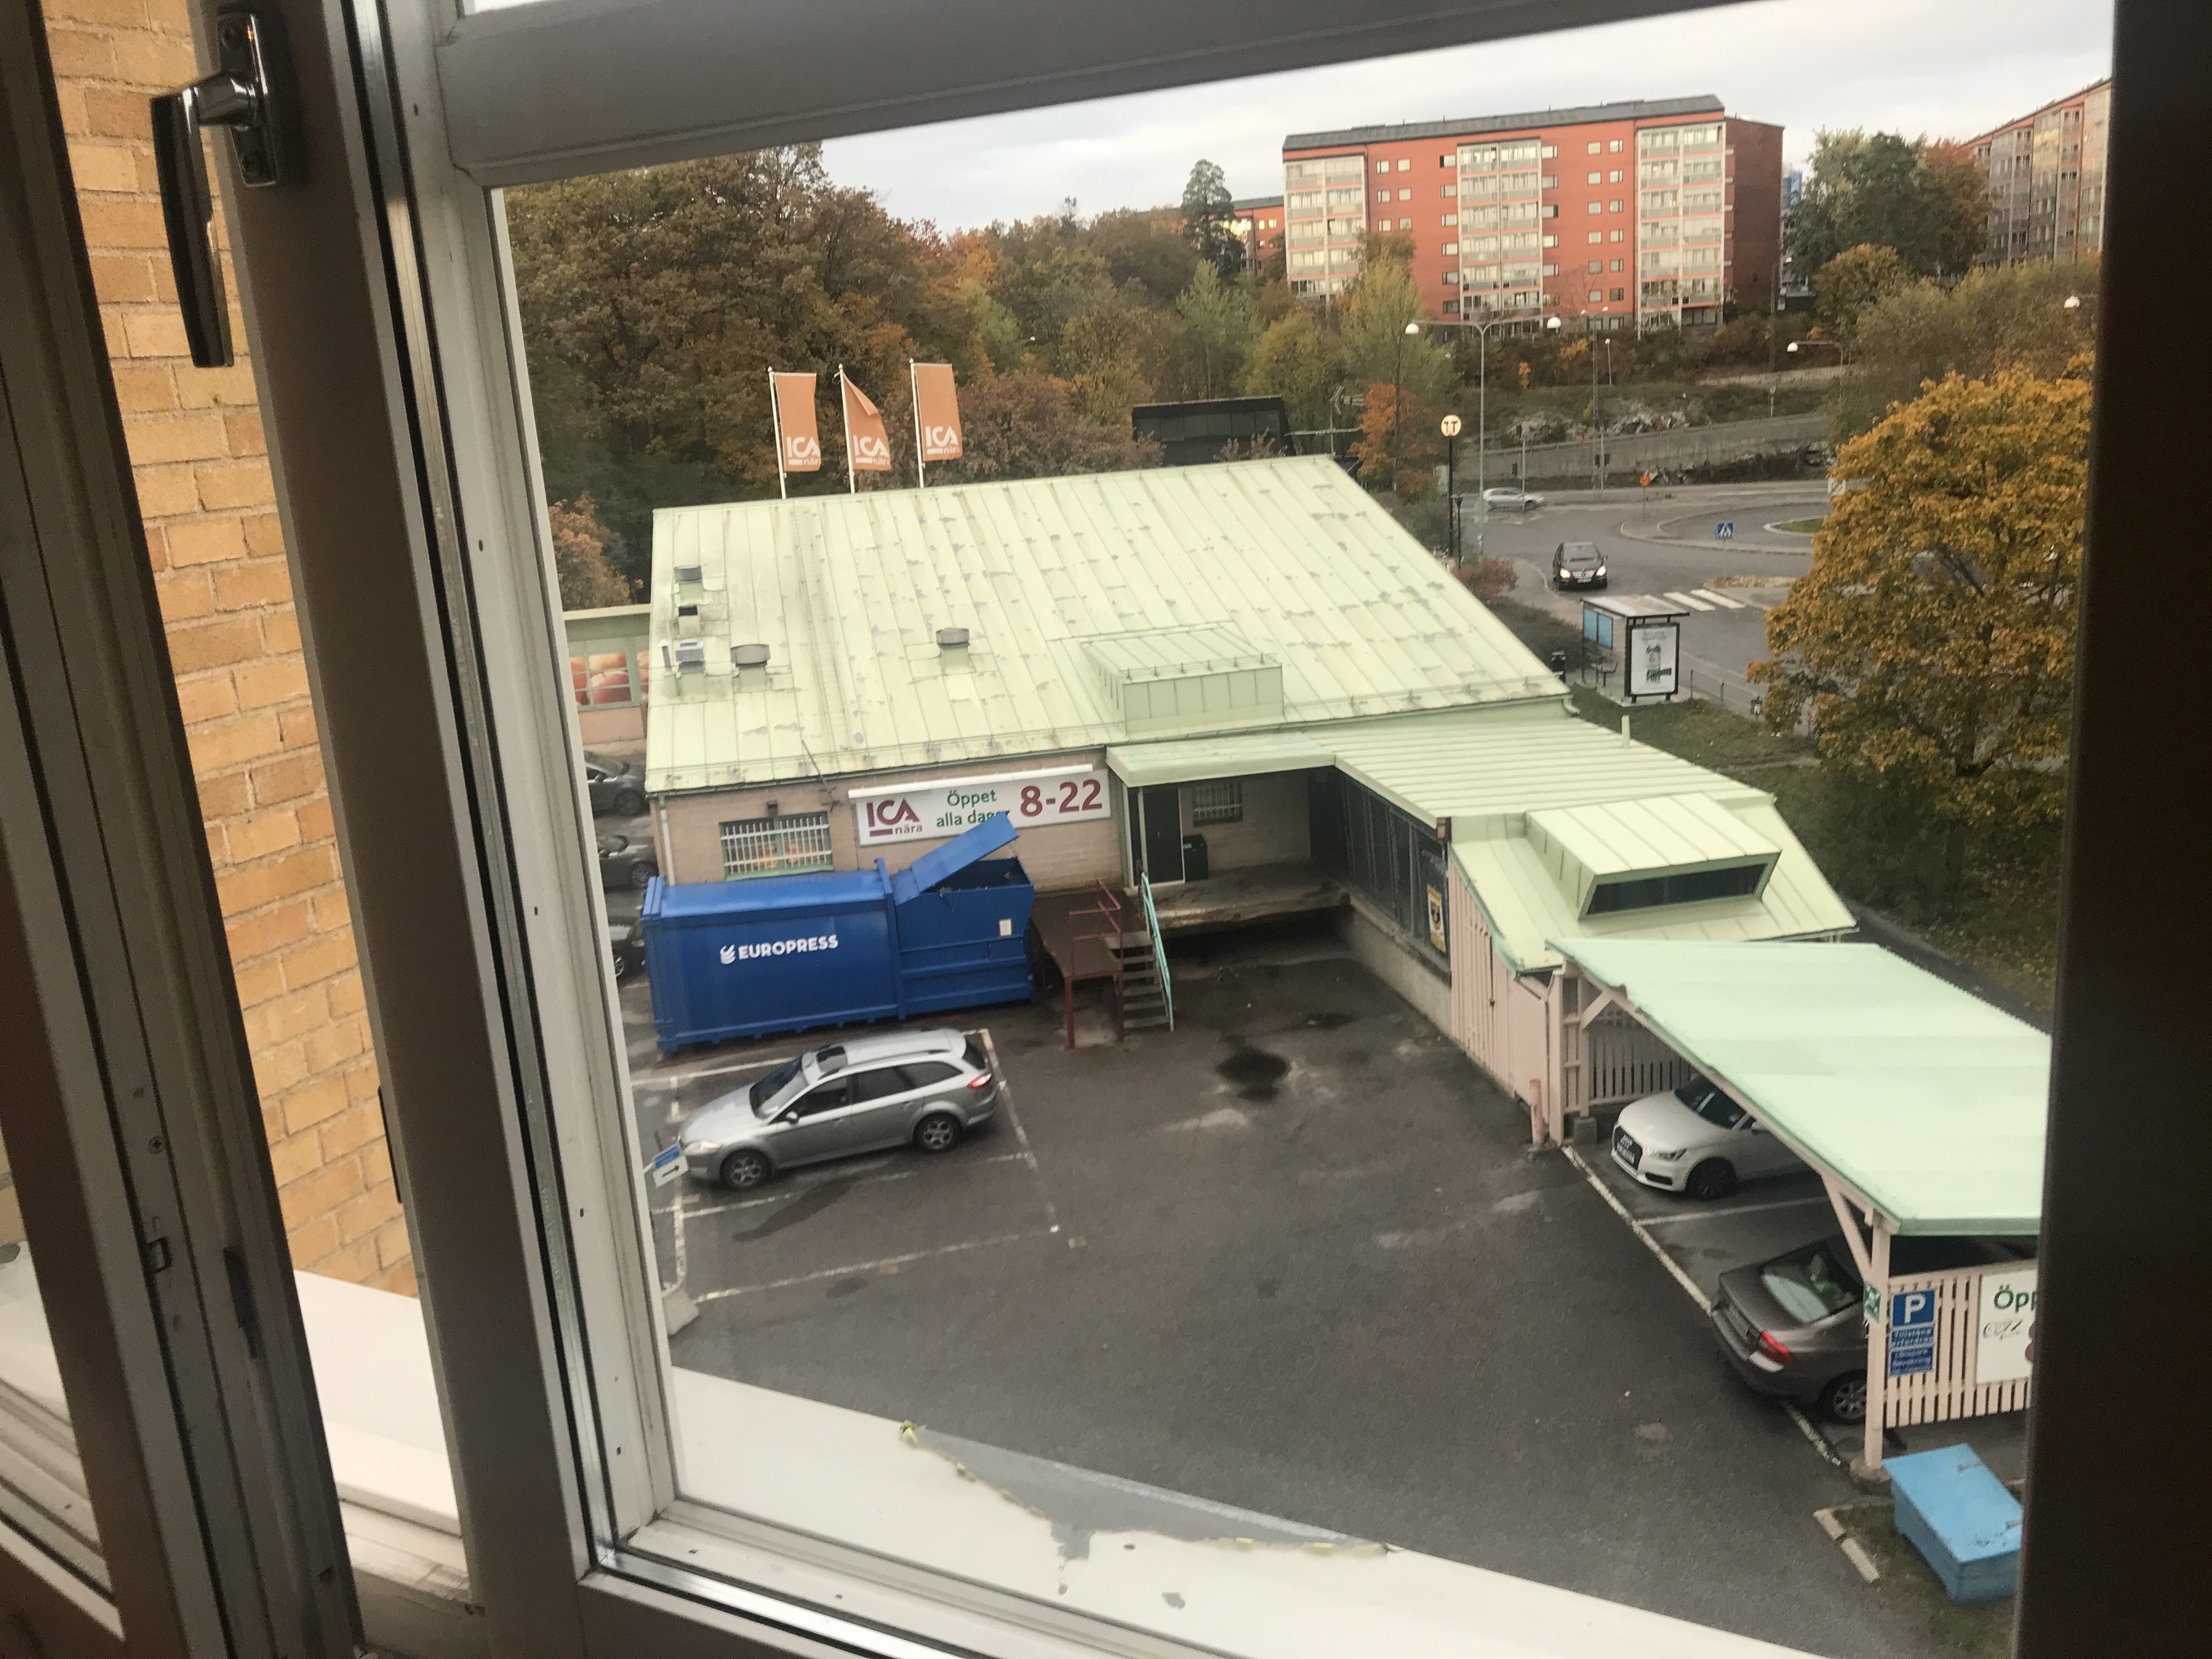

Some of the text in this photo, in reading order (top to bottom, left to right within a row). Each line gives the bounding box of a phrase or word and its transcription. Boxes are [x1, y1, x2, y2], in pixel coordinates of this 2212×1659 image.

[787, 436, 821, 458] ICA
[853, 435, 889, 458] ICA
[925, 425, 958, 447] ICA
[947, 789, 997, 809] Öppet
[1020, 779, 1103, 817] 8-22
[866, 798, 921, 828] ICA
[936, 812, 962, 827] alla
[894, 824, 923, 835] nära
[738, 934, 839, 960] EUROPRESS
[1904, 1293, 1926, 1324] P
